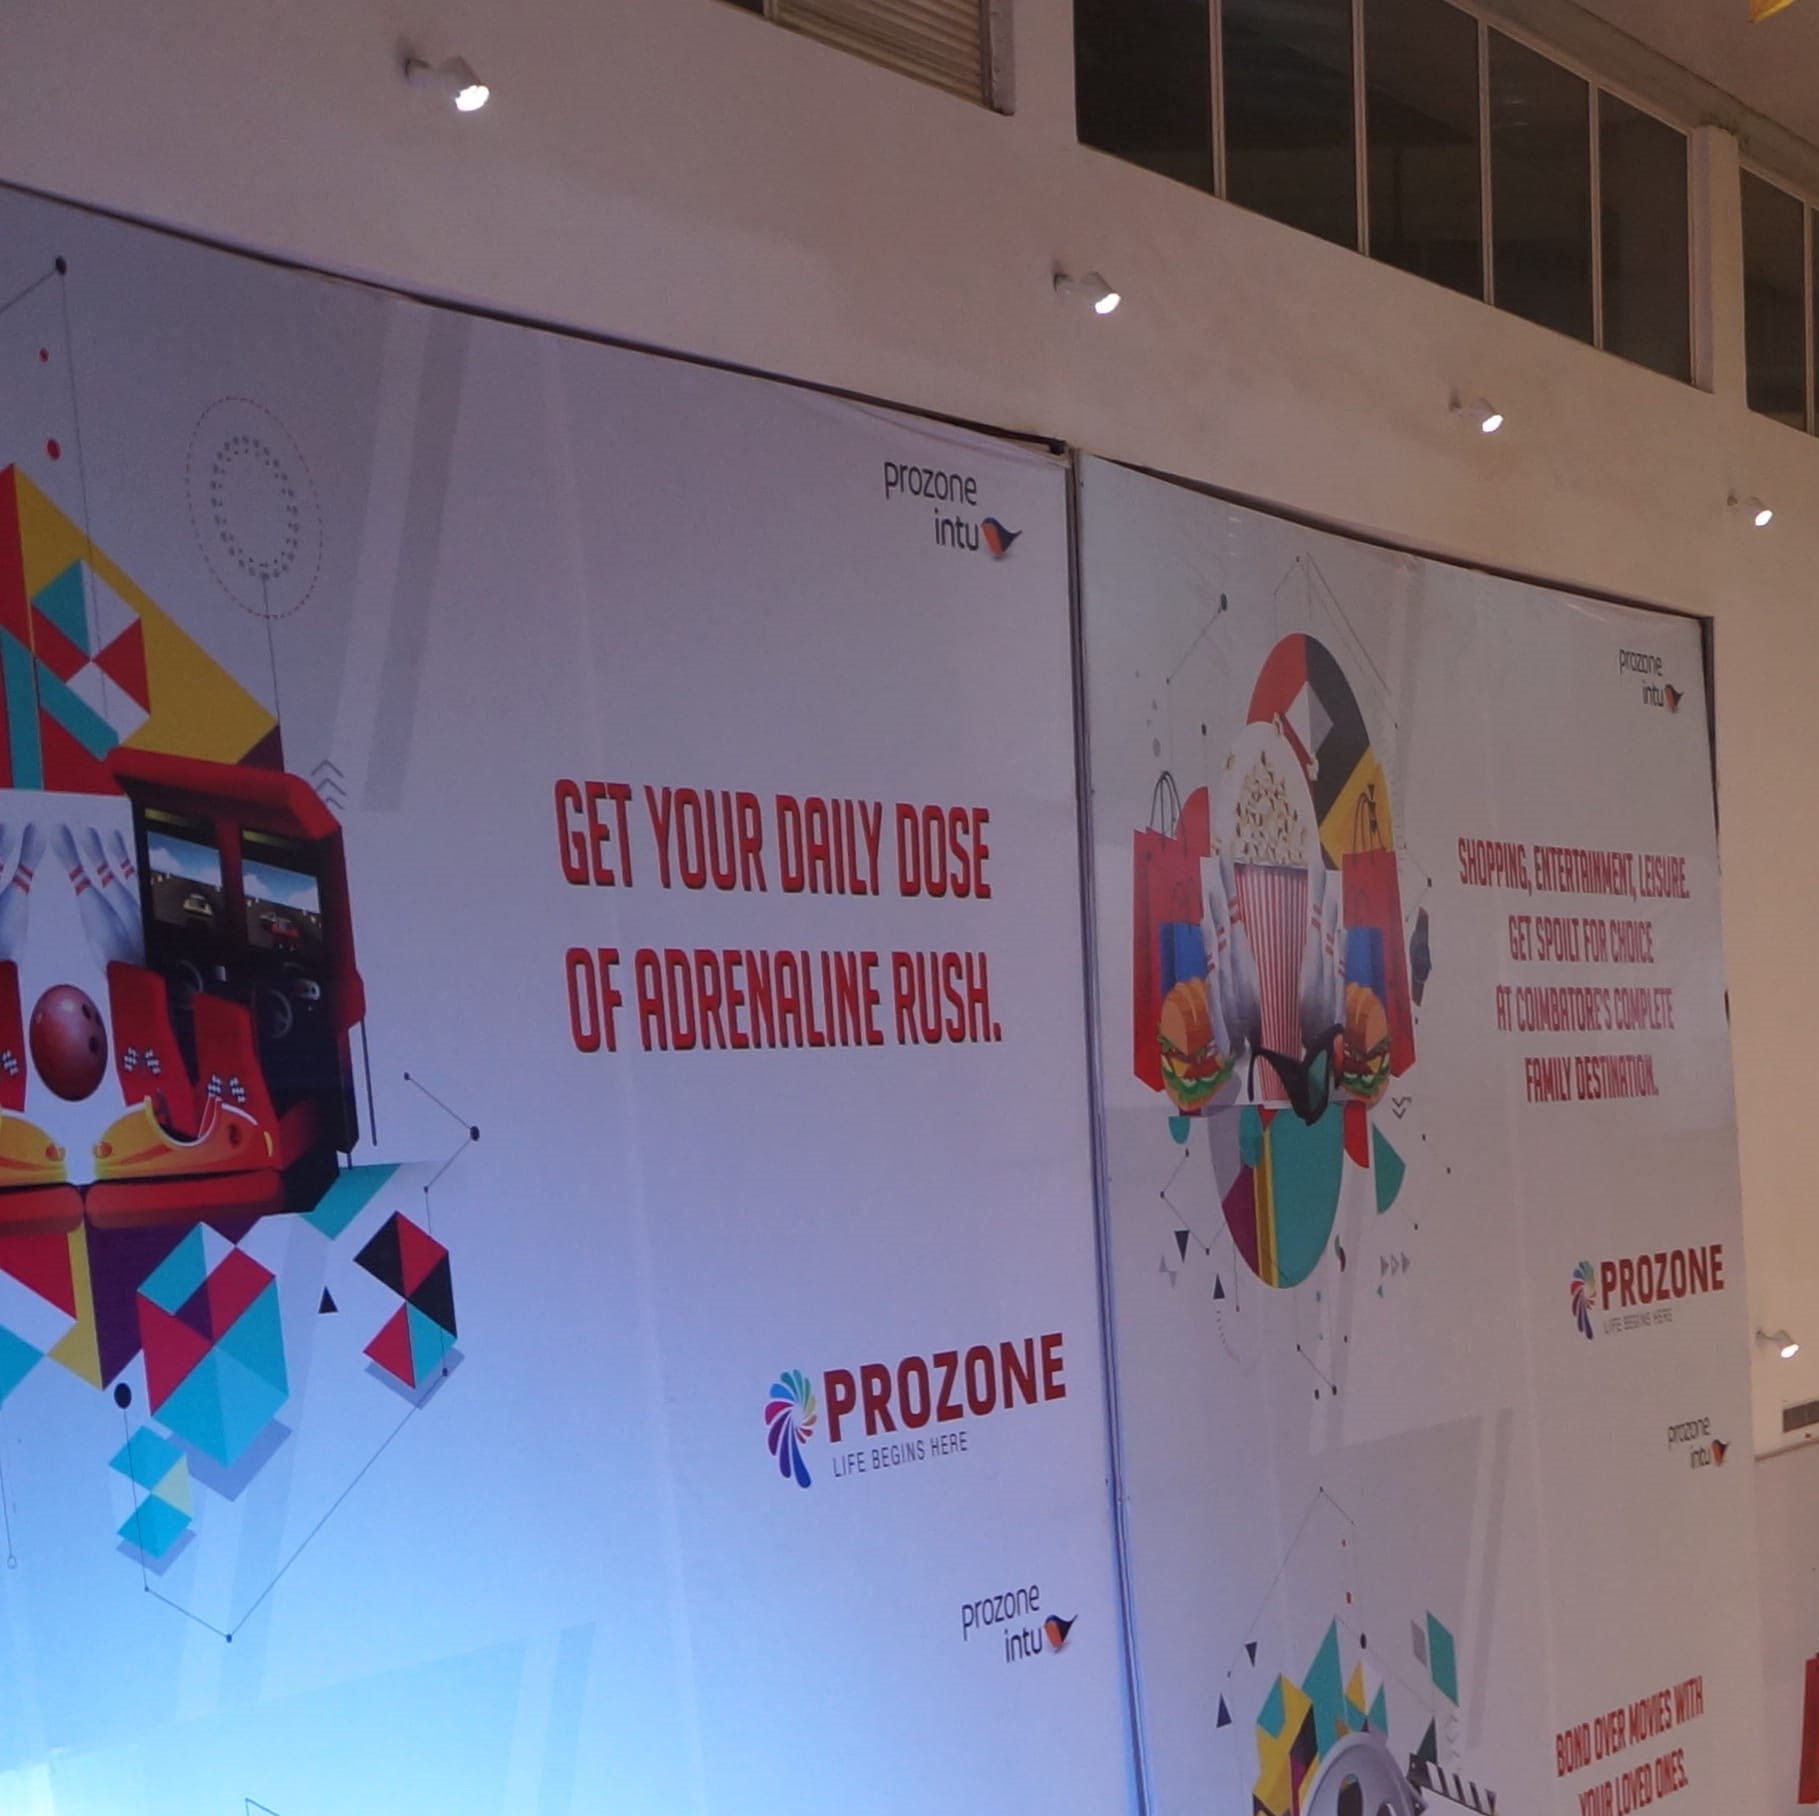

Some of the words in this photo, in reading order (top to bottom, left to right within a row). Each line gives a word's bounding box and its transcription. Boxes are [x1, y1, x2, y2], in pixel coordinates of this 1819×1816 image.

[884, 461, 977, 506] prozone
[935, 510, 980, 551] intu
[1618, 647, 1663, 678] prozone
[1642, 680, 1664, 708] intu
[555, 779, 633, 889] GET
[644, 786, 763, 893] YOUR
[777, 795, 882, 896] DAILY
[896, 806, 992, 899] DOSE
[1458, 837, 1532, 897] SHOPPING,
[1534, 845, 1636, 902] ENTERTAINMENT,
[1639, 854, 1690, 899] LEISURE.
[1509, 915, 1534, 960] GET
[1537, 918, 1581, 962] SPOILT
[1584, 919, 1606, 963] FOR
[1610, 920, 1654, 964] CHOICE
[565, 946, 621, 1052] OF
[636, 948, 884, 1049] ADRENALINE
[895, 951, 1002, 1046] RUSH.
[1496, 985, 1514, 1030] AT
[1517, 987, 1612, 1031] COIMBATORE'S
[1614, 988, 1674, 1030] COMPLETE
[1525, 1056, 1571, 1103] FAMILY
[1575, 1055, 1659, 1102] DESTINATION.
[1600, 1243, 1725, 1311] PROZONE
[824, 1332, 1067, 1442] PROZONE
[832, 1452, 866, 1478] LIFE
[872, 1441, 926, 1472] BEGINS
[930, 1432, 968, 1457] HERE
[1668, 1417, 1710, 1450] prozone
[961, 1584, 1040, 1641] prozone
[1004, 1624, 1043, 1665] intu
[1555, 1724, 1593, 1779] BOND
[1596, 1707, 1626, 1761] OVER
[1628, 1689, 1673, 1750] MOVIES
[1674, 1675, 1704, 1725] WITH
[1654, 1747, 1689, 1800] ONES.
